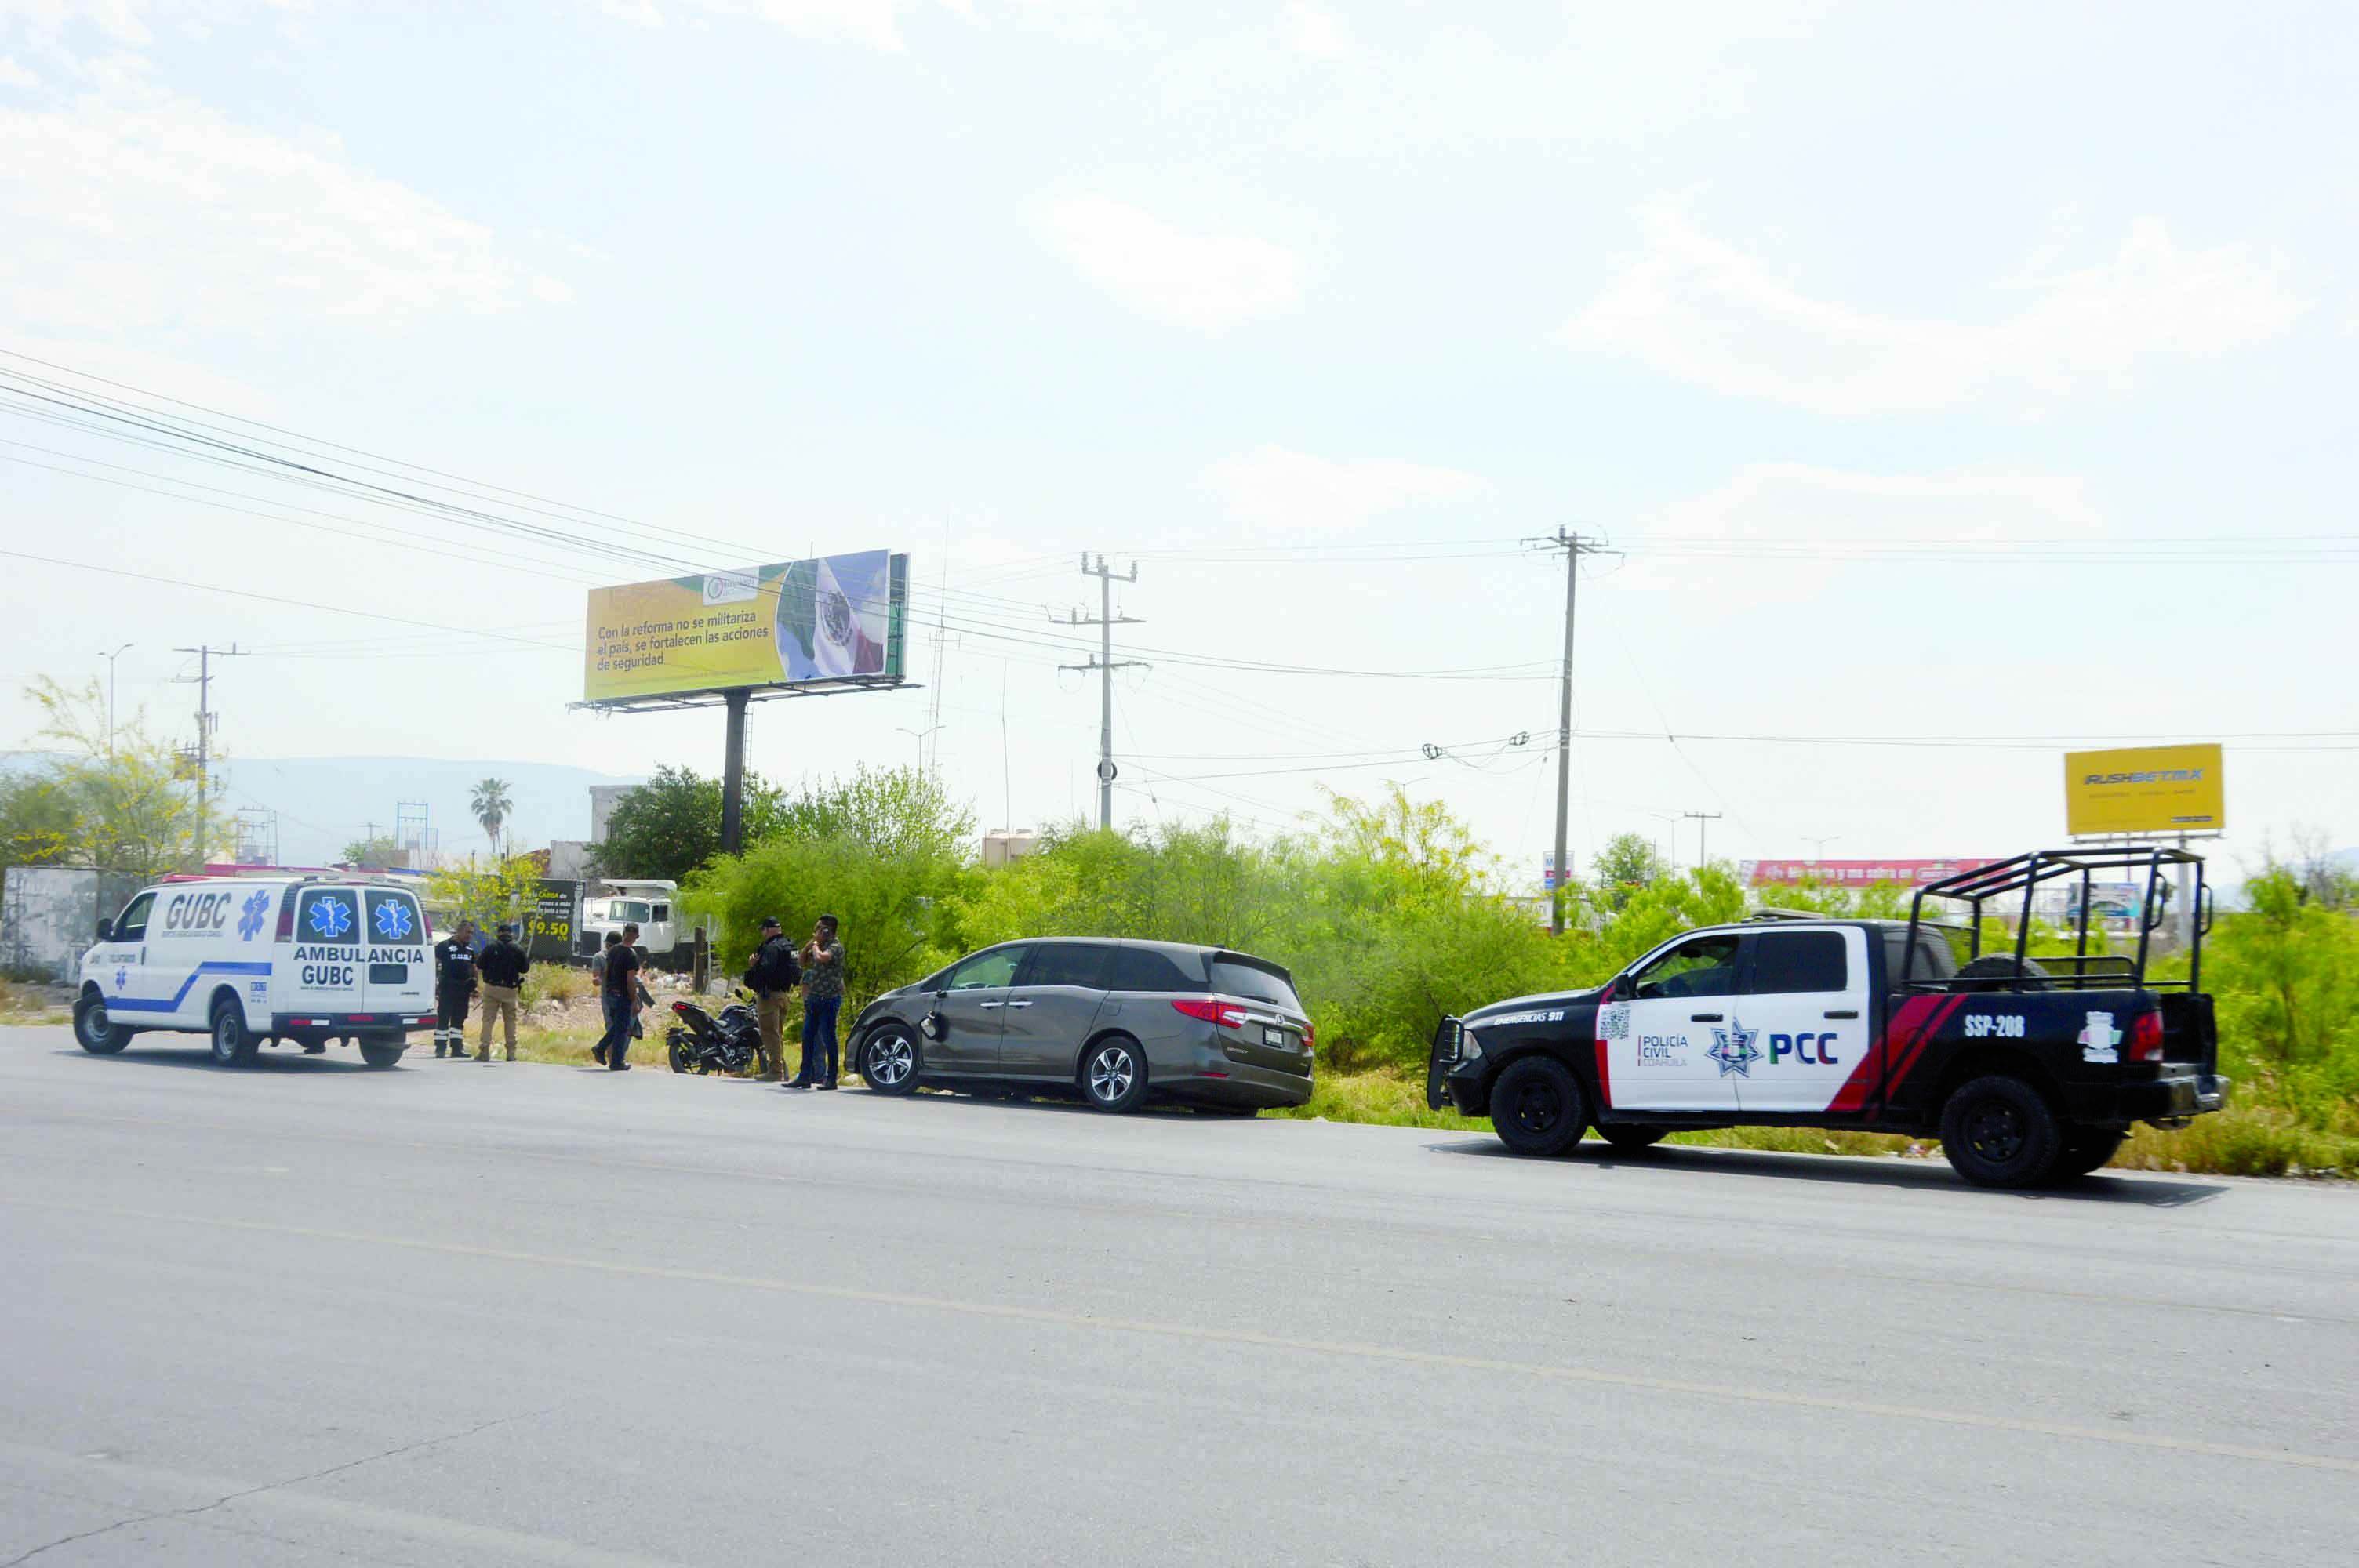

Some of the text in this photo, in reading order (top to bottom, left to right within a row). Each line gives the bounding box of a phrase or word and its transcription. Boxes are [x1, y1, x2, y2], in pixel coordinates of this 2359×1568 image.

[598, 610, 757, 640] Con la reforma no se militariza
[598, 642, 607, 655] el
[635, 640, 647, 652] se
[650, 633, 703, 650] fortalecen
[705, 630, 719, 644] las
[722, 626, 769, 641] acciones
[597, 652, 664, 672] de seguridad
[166, 891, 231, 929] GUBC
[527, 919, 569, 935] $9.50
[293, 946, 424, 964] AMBULANCIA
[302, 965, 354, 985] GUBC
[1547, 1011, 1565, 1022] 911
[1965, 1014, 2025, 1037] SSP-208
[1643, 1033, 1688, 1047] POLICÍA
[1769, 1033, 1838, 1065] PCC
[1643, 1047, 1672, 1058] CIVIL
